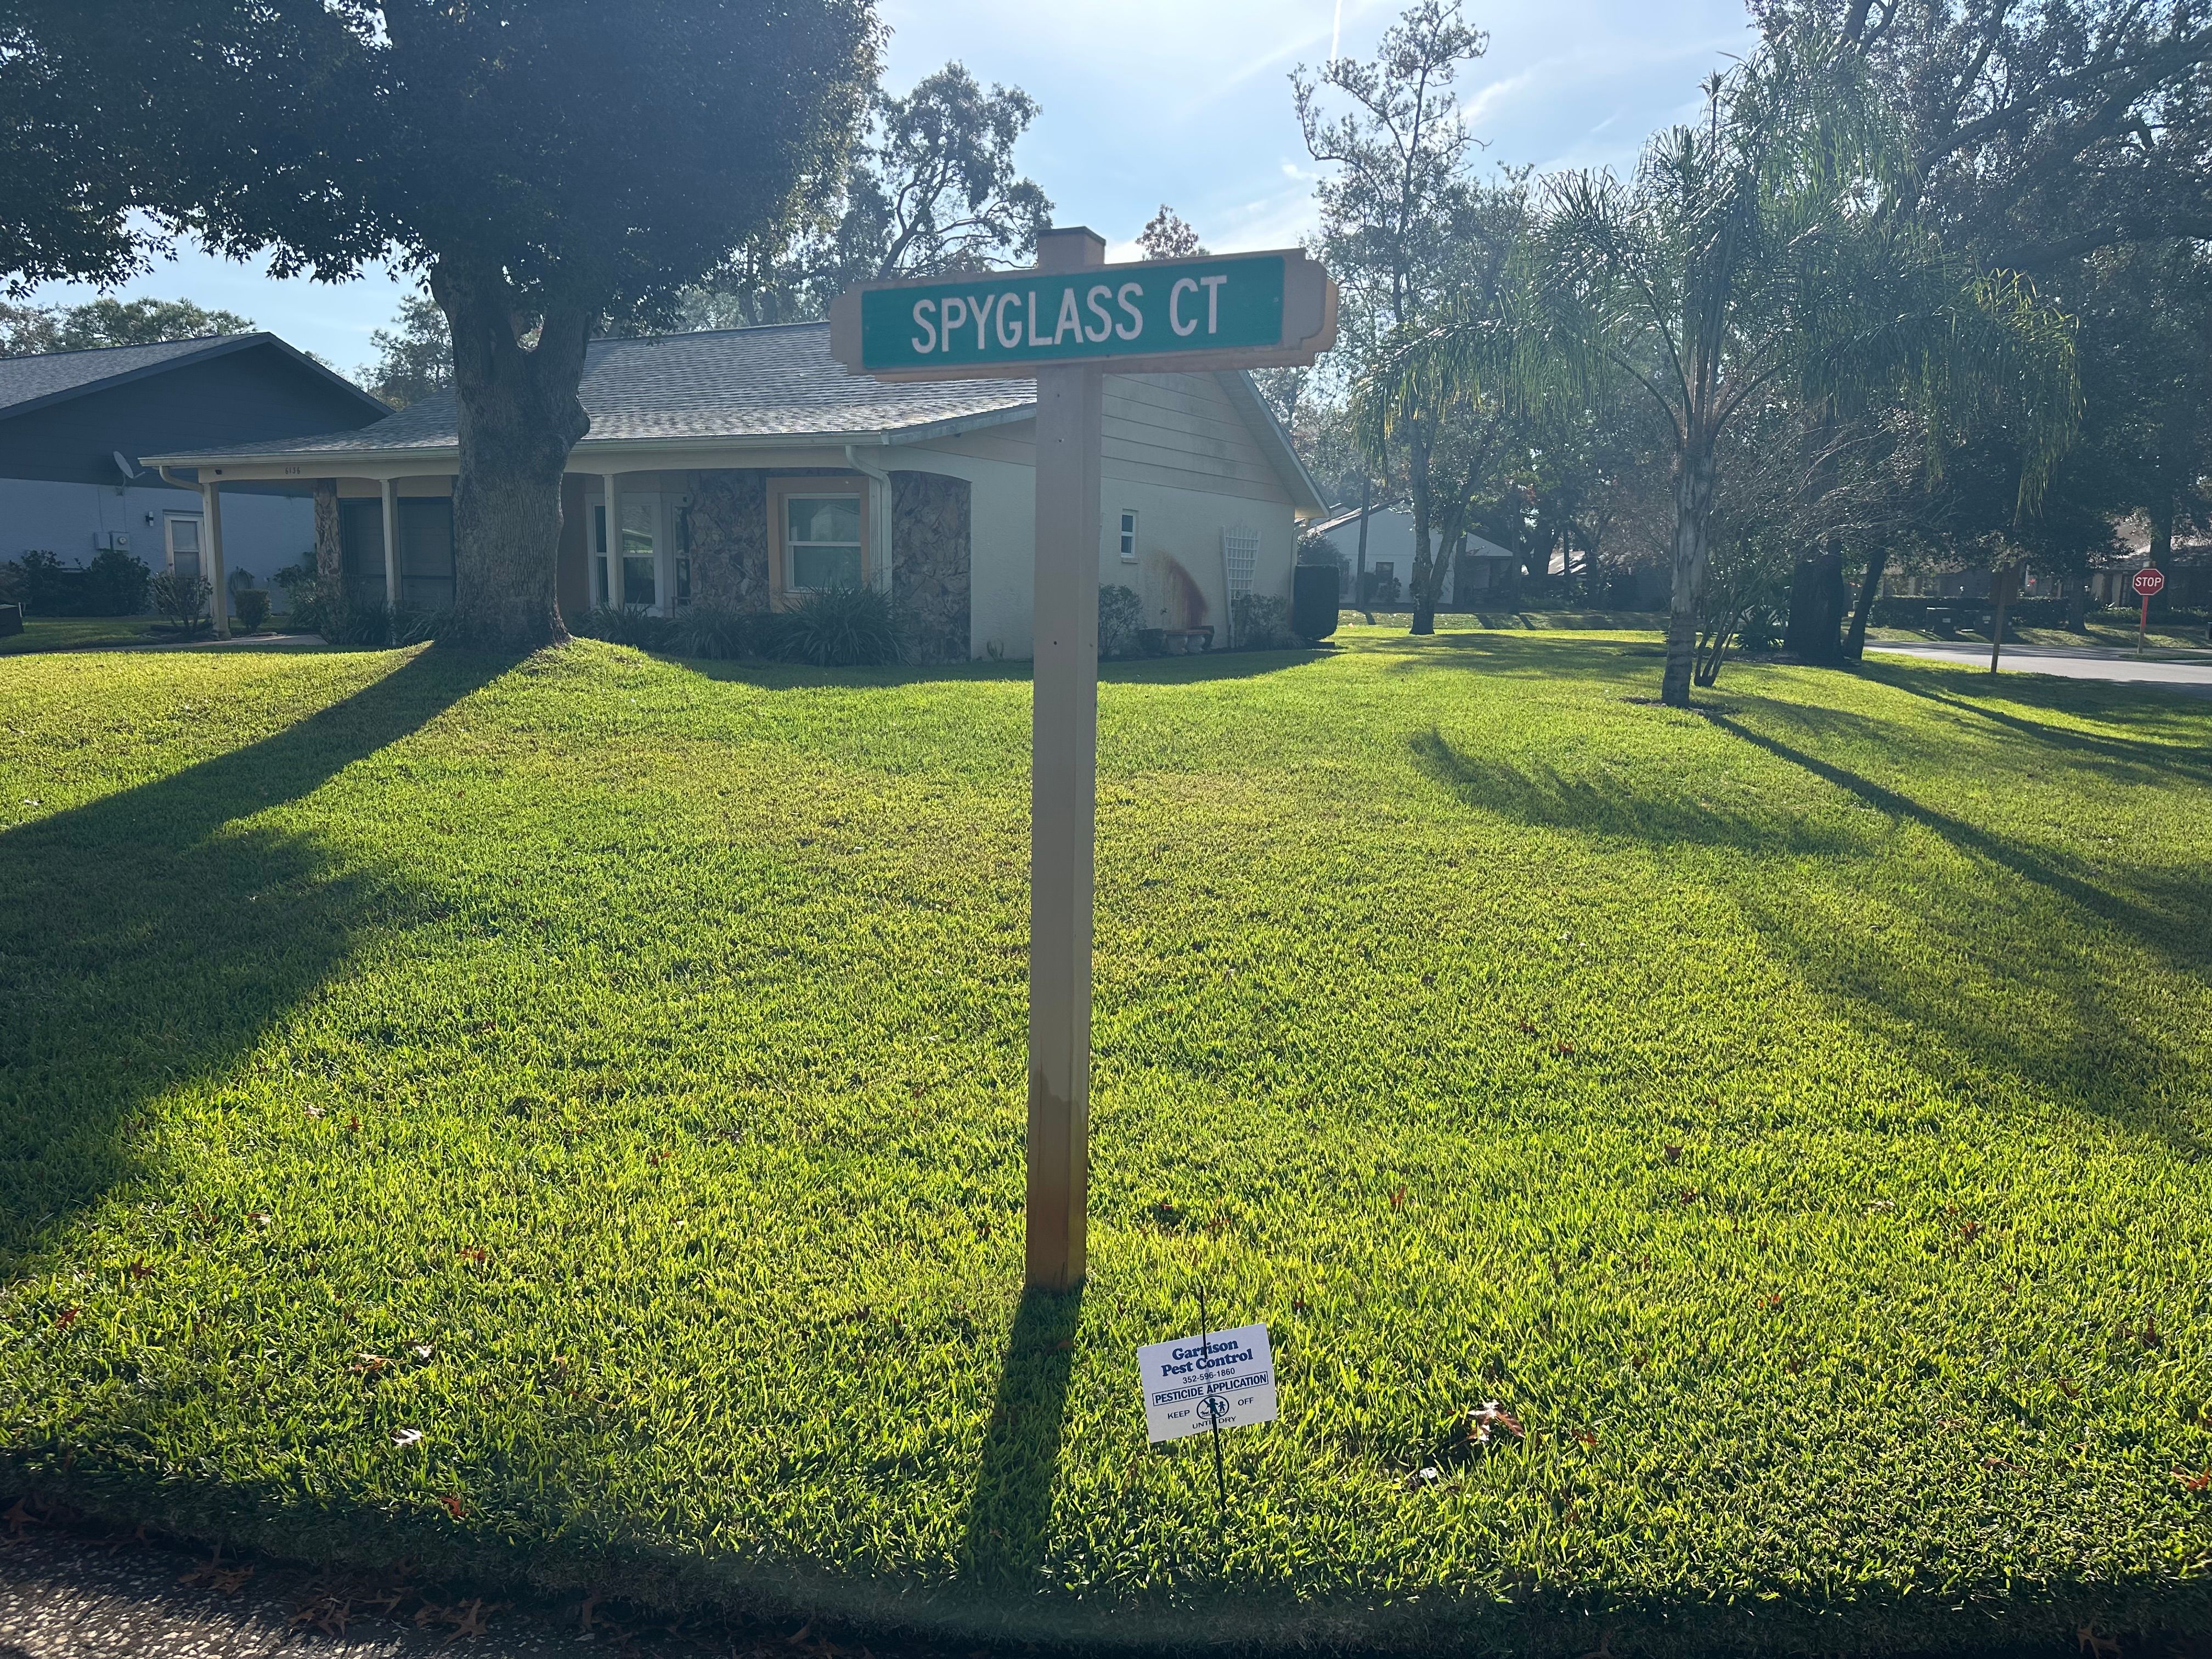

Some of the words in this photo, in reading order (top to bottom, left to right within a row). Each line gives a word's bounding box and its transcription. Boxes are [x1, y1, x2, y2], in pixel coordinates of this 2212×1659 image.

[912, 282, 1144, 354] SPYGLASS
[1170, 275, 1227, 336] CT
[2135, 577, 2162, 587] STOP
[1172, 1340, 1239, 1361] Garrison
[1161, 1362, 1194, 1377] Pest
[1195, 1348, 1254, 1370] Control
[1182, 1367, 1235, 1384] 352-596-1860
[1154, 1386, 1204, 1404] PESTICIDE
[1206, 1374, 1267, 1394] APPLICATION
[1167, 1409, 1190, 1420] KEEP
[1237, 1397, 1254, 1406] OFF
[1192, 1419, 1215, 1429] UNTI
